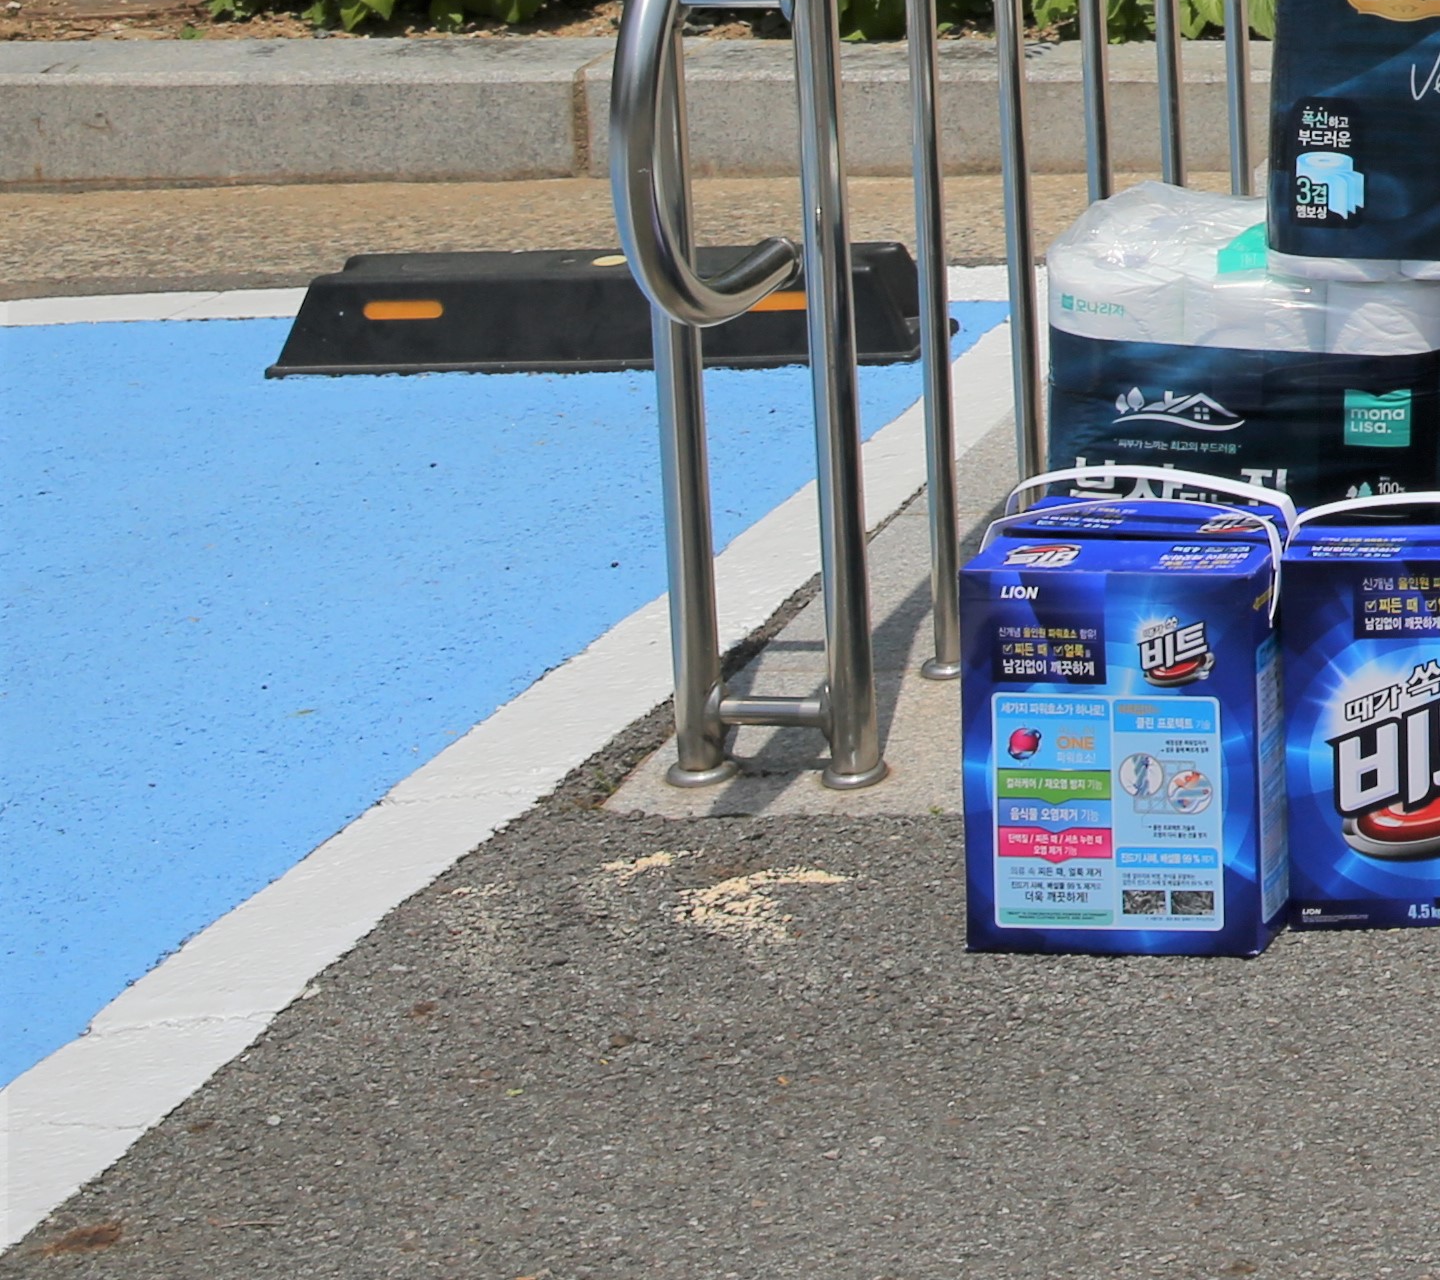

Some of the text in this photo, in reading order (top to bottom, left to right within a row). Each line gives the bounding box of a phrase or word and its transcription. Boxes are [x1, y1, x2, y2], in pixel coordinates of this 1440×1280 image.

[1302, 109, 1349, 128] 폭신하고
[1298, 129, 1351, 148] 부드러운
[1296, 177, 1327, 204] 3겹
[1296, 205, 1327, 219] 엠보싱
[1000, 586, 1039, 600] LION
[1365, 617, 1440, 630] 남김없이 깨끗하게
[1140, 622, 1207, 670] 비트
[1003, 660, 1095, 676] 남김없이 깨끗하게
[1345, 686, 1400, 724] 때가
[1057, 736, 1095, 750] ONE
